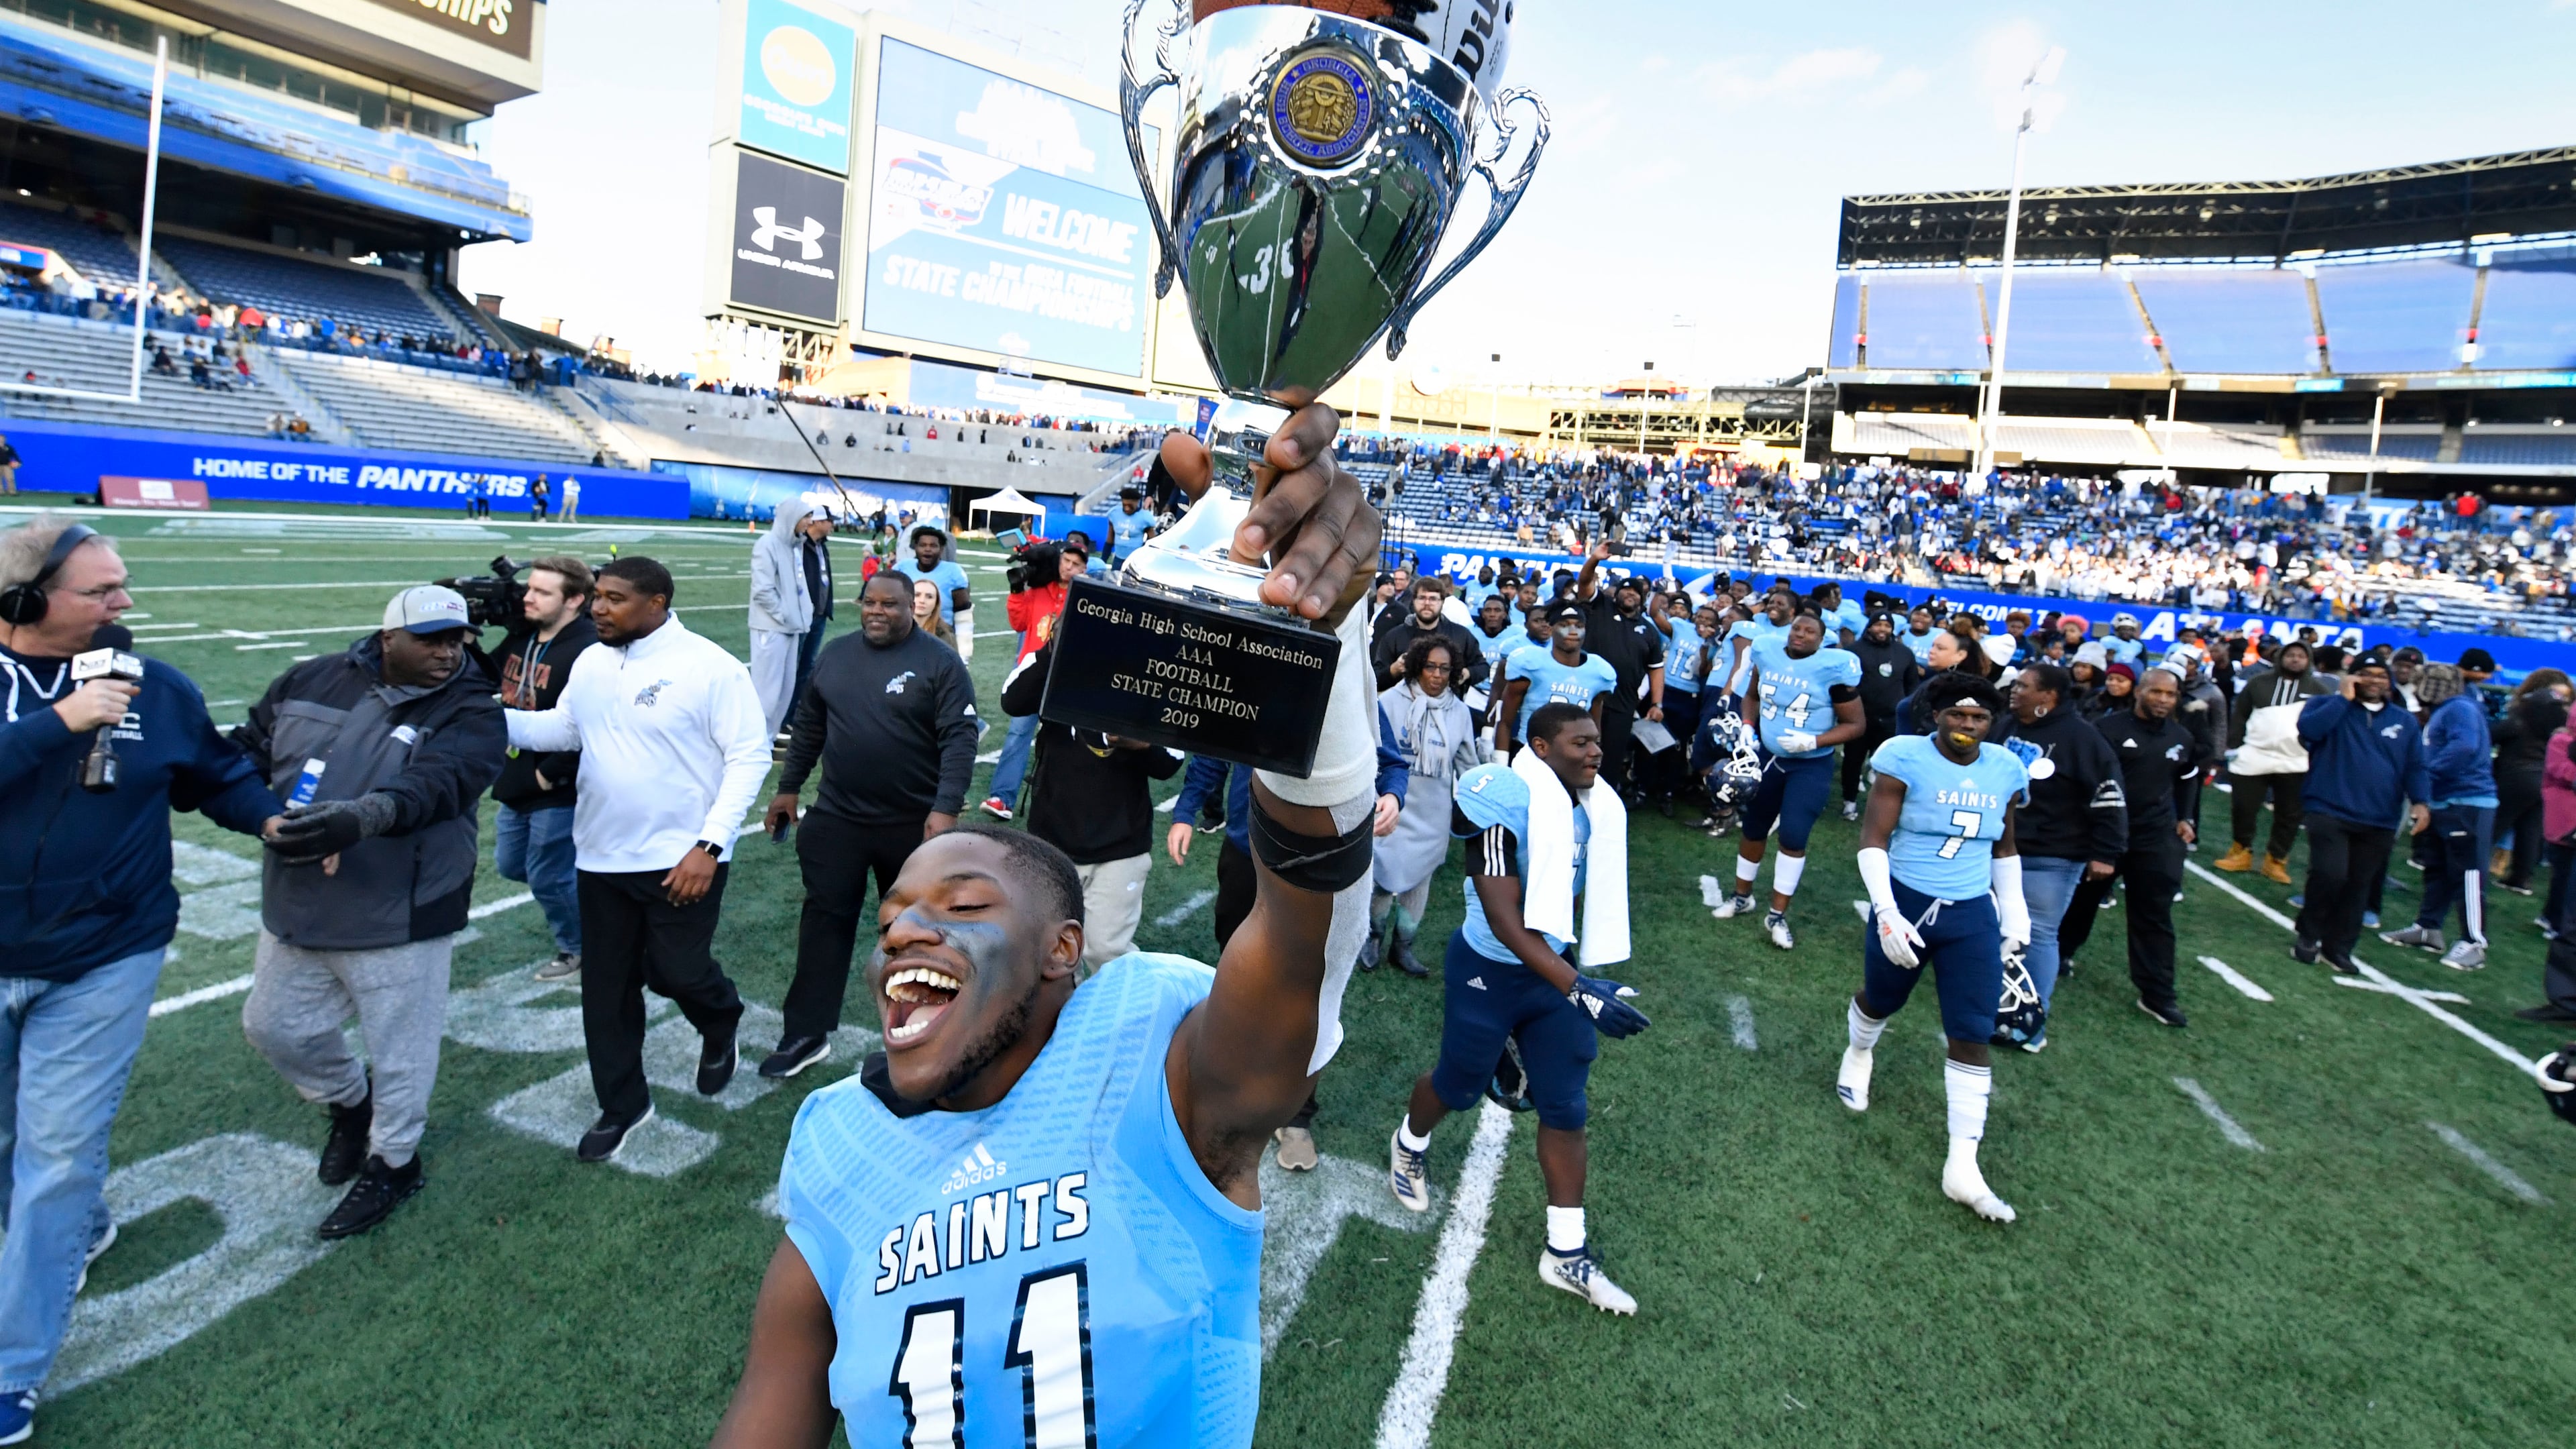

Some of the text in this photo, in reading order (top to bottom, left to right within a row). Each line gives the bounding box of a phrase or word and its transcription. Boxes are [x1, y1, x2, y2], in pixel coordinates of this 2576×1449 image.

[1002, 193, 1138, 264] WELCOME
[883, 254, 1136, 332] STATE CHAMPIONSHIPS
[1065, 271, 1134, 306] FOOTBALL
[193, 458, 529, 498] HOME OF THE PANTHRS
[1076, 598, 1324, 670] Georgia High School Association
[1175, 644, 1214, 667] AAA
[1145, 658, 1234, 694] FOOTBALL
[1550, 682, 1590, 698] SAINTS
[1766, 671, 1809, 690] SAINTS
[1111, 673, 1260, 721] STATE CHAMPION
[1760, 682, 1811, 729] 54
[1161, 707, 1200, 729] 2019
[1470, 773, 1495, 794] 5
[1936, 789, 1997, 809] SAINTS
[1936, 808, 1982, 859] 7
[941, 1161, 1006, 1196] adidas
[874, 1170, 1090, 1296] SAINTS
[888, 1257, 1097, 1449] 11
